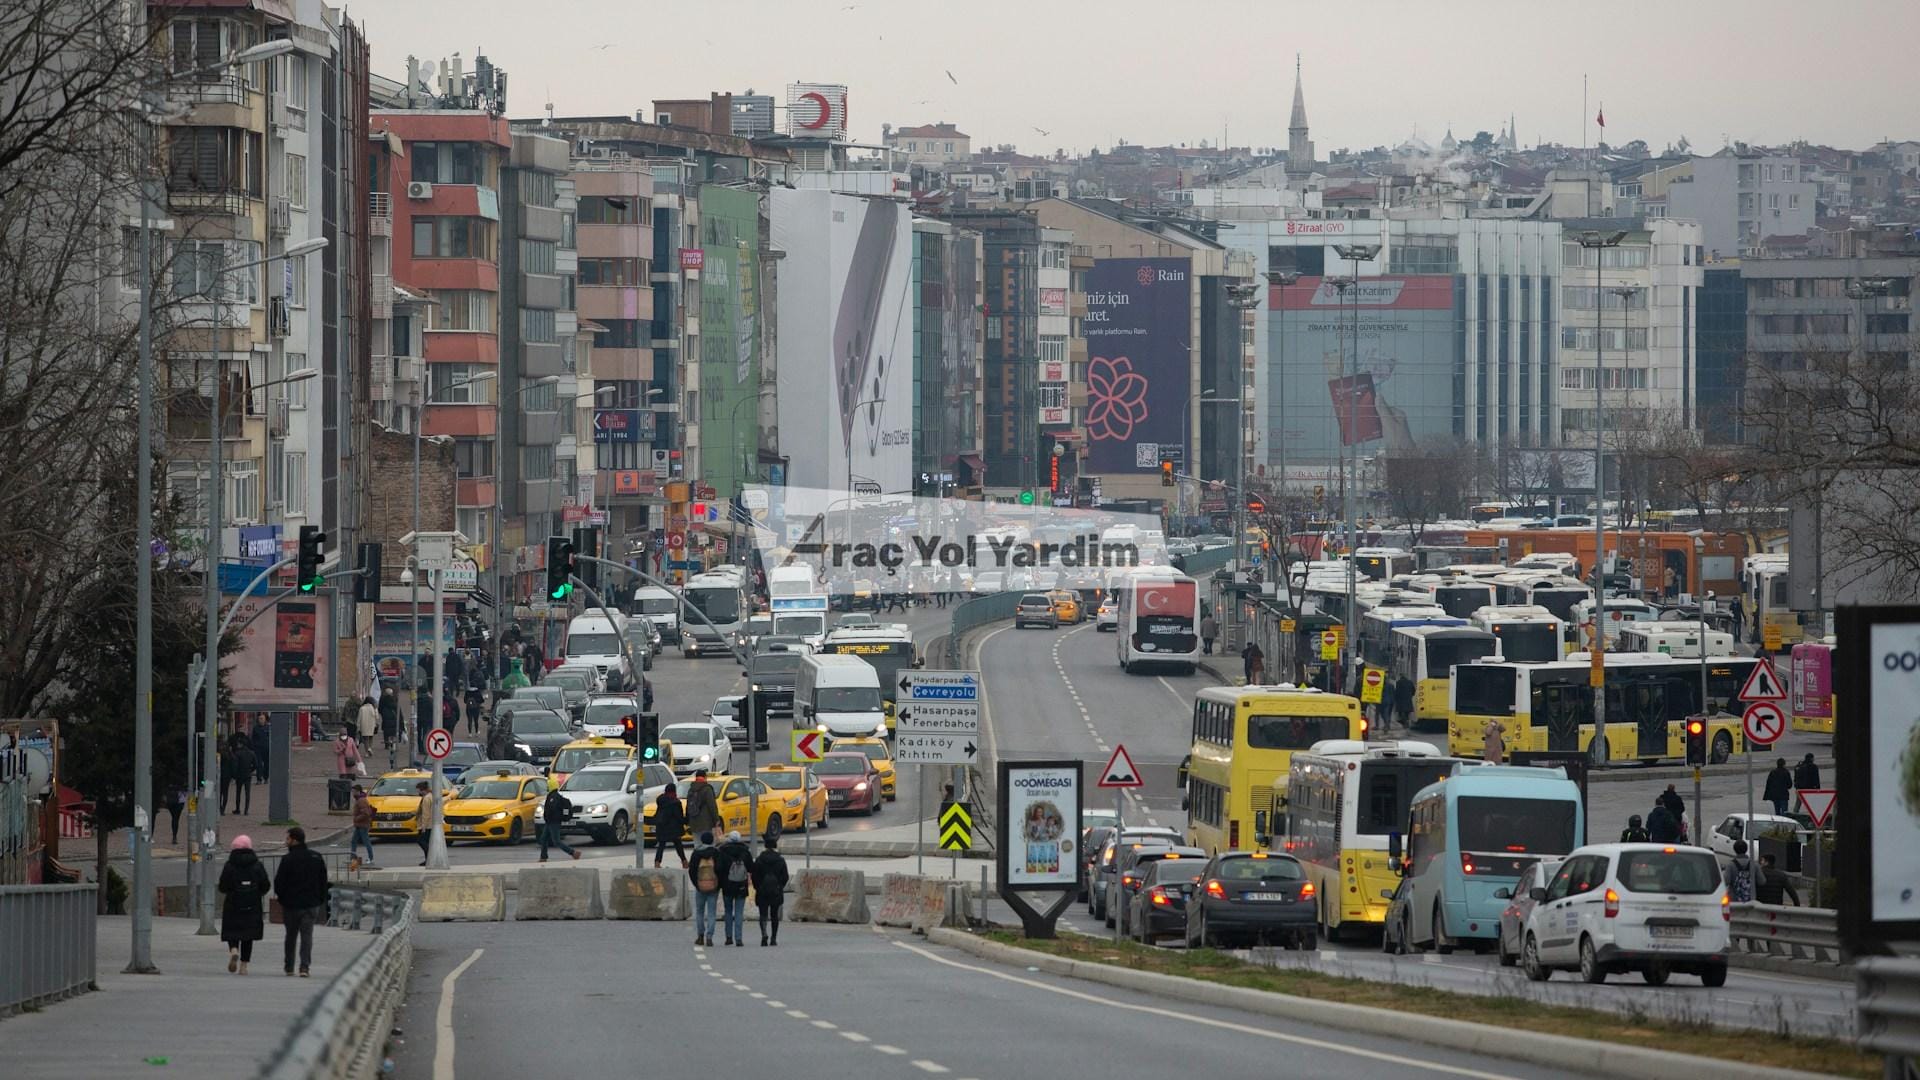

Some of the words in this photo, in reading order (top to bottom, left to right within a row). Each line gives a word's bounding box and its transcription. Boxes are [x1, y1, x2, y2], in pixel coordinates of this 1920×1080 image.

[1297, 223, 1323, 232] Ziraat
[1326, 223, 1345, 233] GYO
[1158, 269, 1184, 281] Rain
[1084, 291, 1105, 305] niz
[1108, 291, 1129, 308] için
[1104, 328, 1133, 337] platformu
[914, 687, 975, 698] Çevreyolu
[913, 706, 976, 717] Hasanpaşa
[913, 719, 976, 728] Fenerbahçe
[899, 737, 953, 749] Kadıköy
[899, 750, 942, 758] Rıhtım
